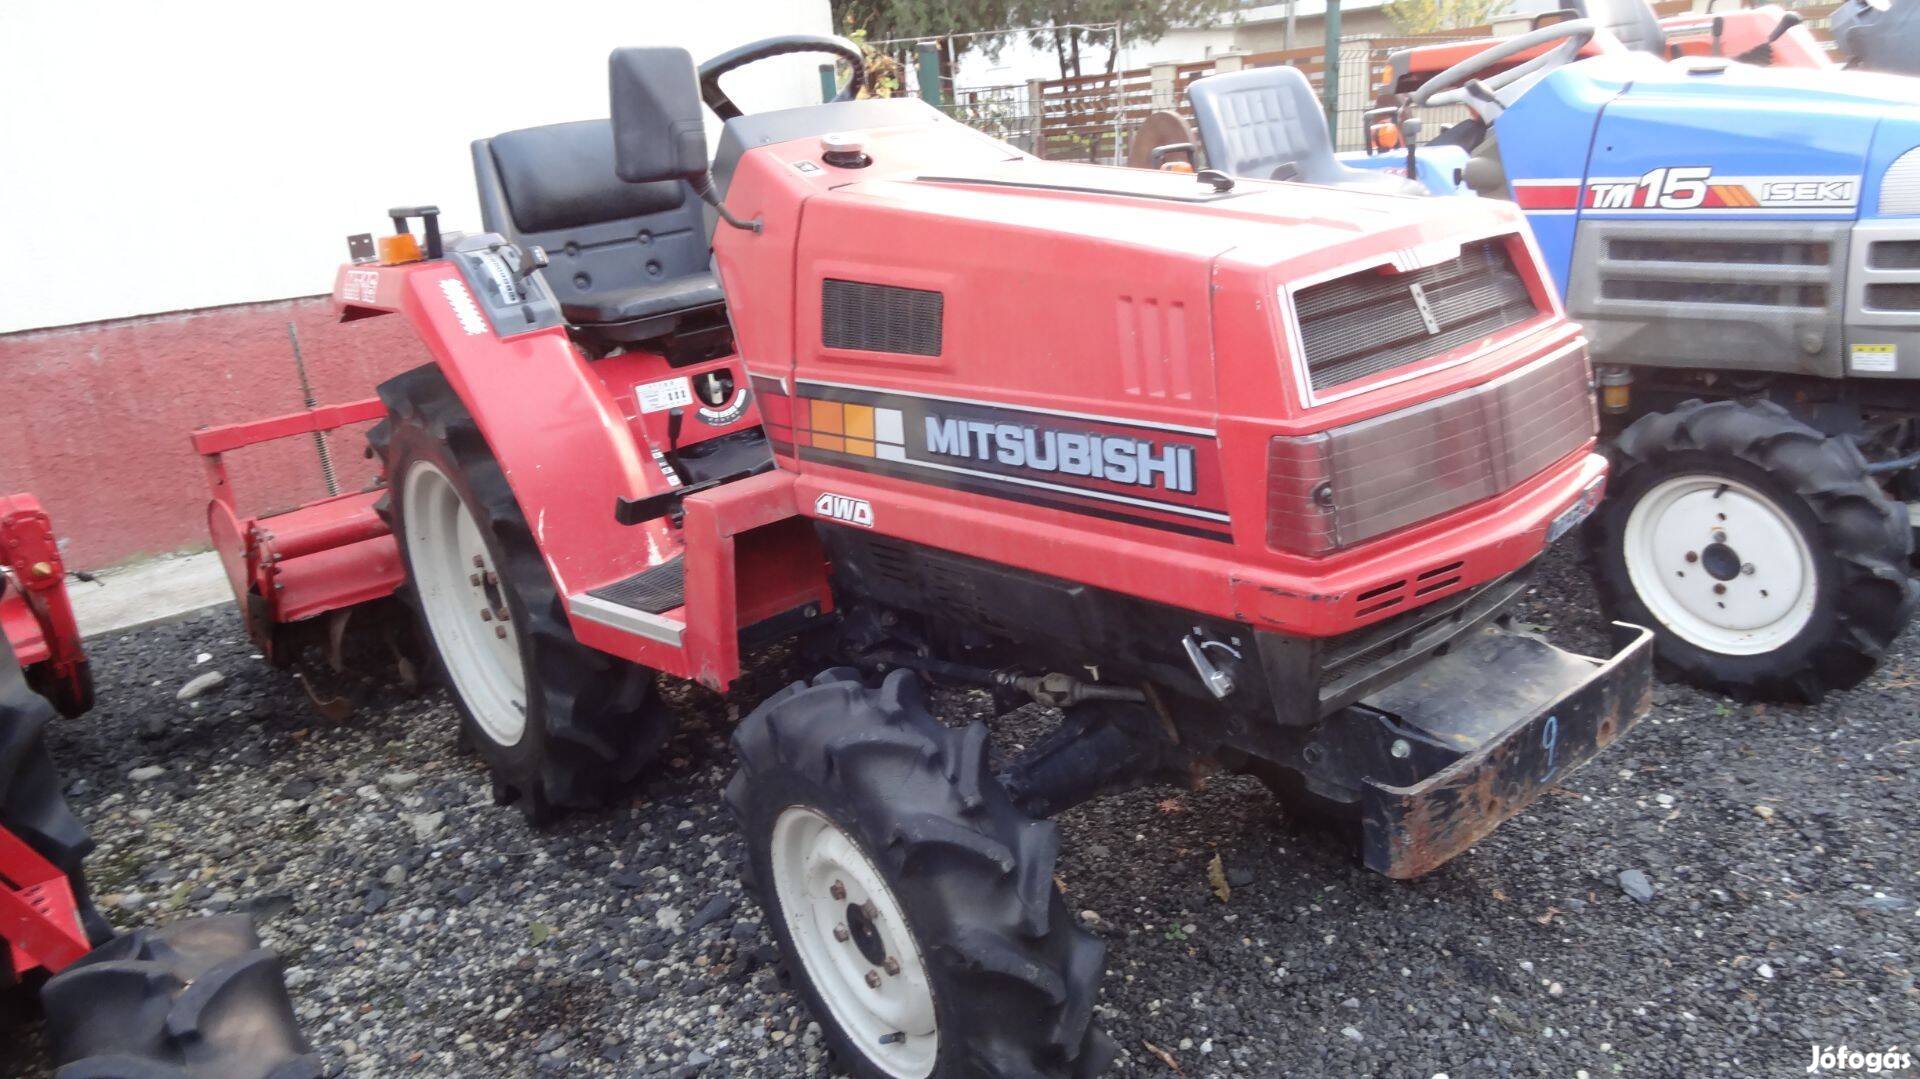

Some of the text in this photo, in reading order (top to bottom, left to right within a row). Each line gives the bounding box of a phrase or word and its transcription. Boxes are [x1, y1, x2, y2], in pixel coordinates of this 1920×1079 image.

[1761, 181, 1854, 200] ISEKI
[925, 416, 1195, 492] MITSUBISHI
[1542, 716, 1558, 769] 9
